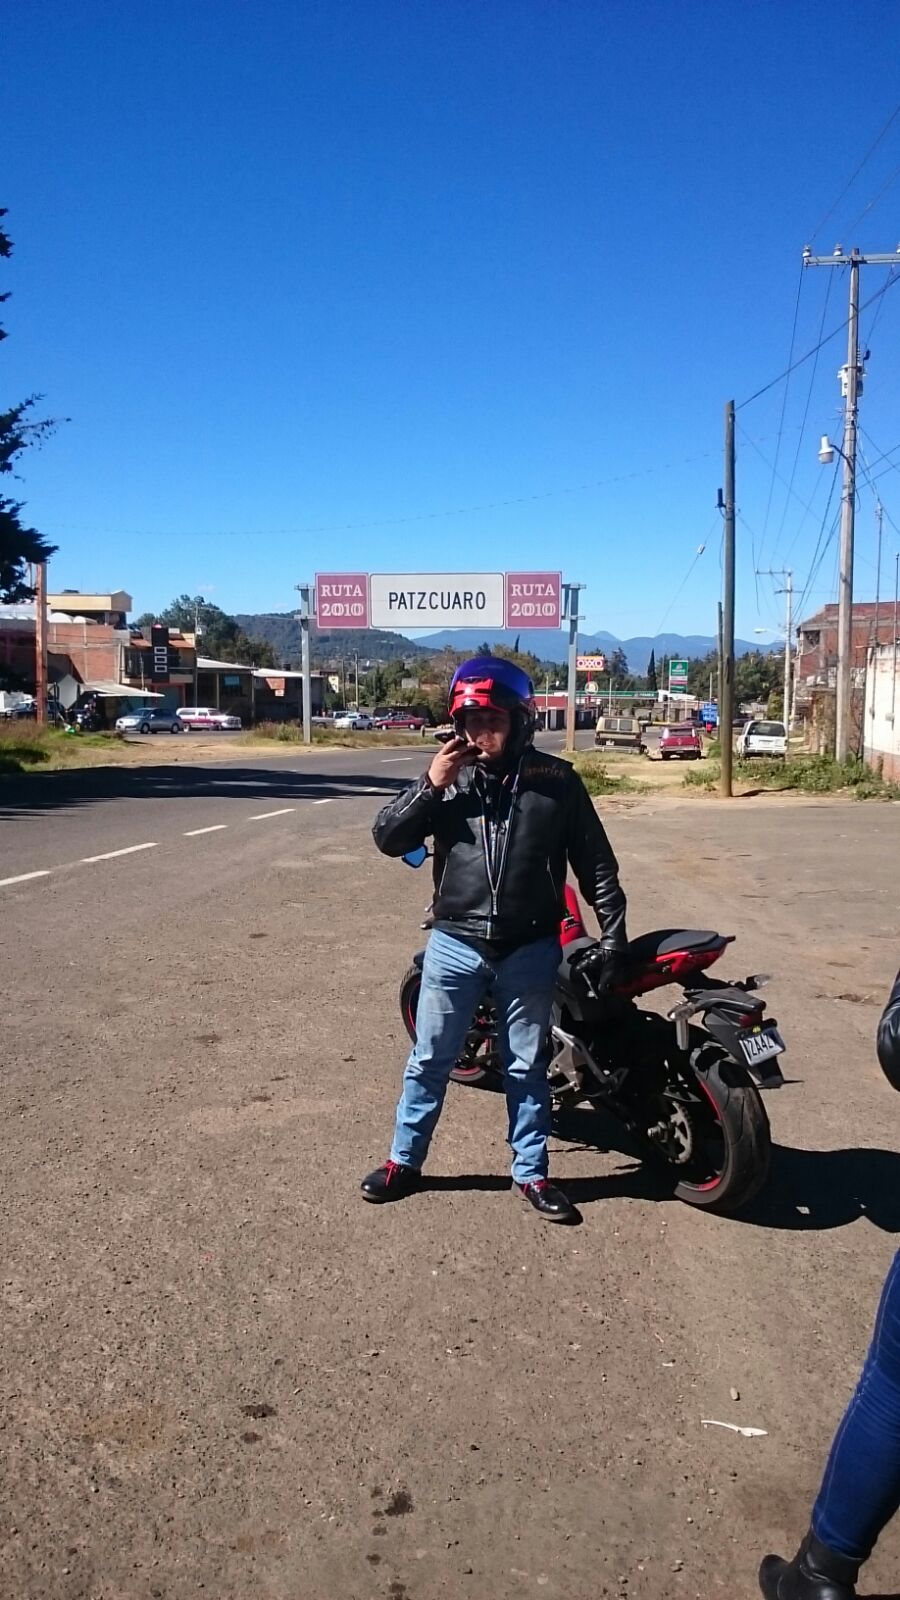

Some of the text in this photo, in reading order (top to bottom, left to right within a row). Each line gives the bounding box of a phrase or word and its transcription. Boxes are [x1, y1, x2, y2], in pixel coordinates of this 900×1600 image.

[320, 584, 364, 597] RUTA
[510, 583, 556, 596] RUTA
[388, 592, 487, 610] PATZCUARO
[321, 603, 365, 617] 2010
[511, 603, 557, 617] 2010
[577, 659, 603, 668] OXXO
